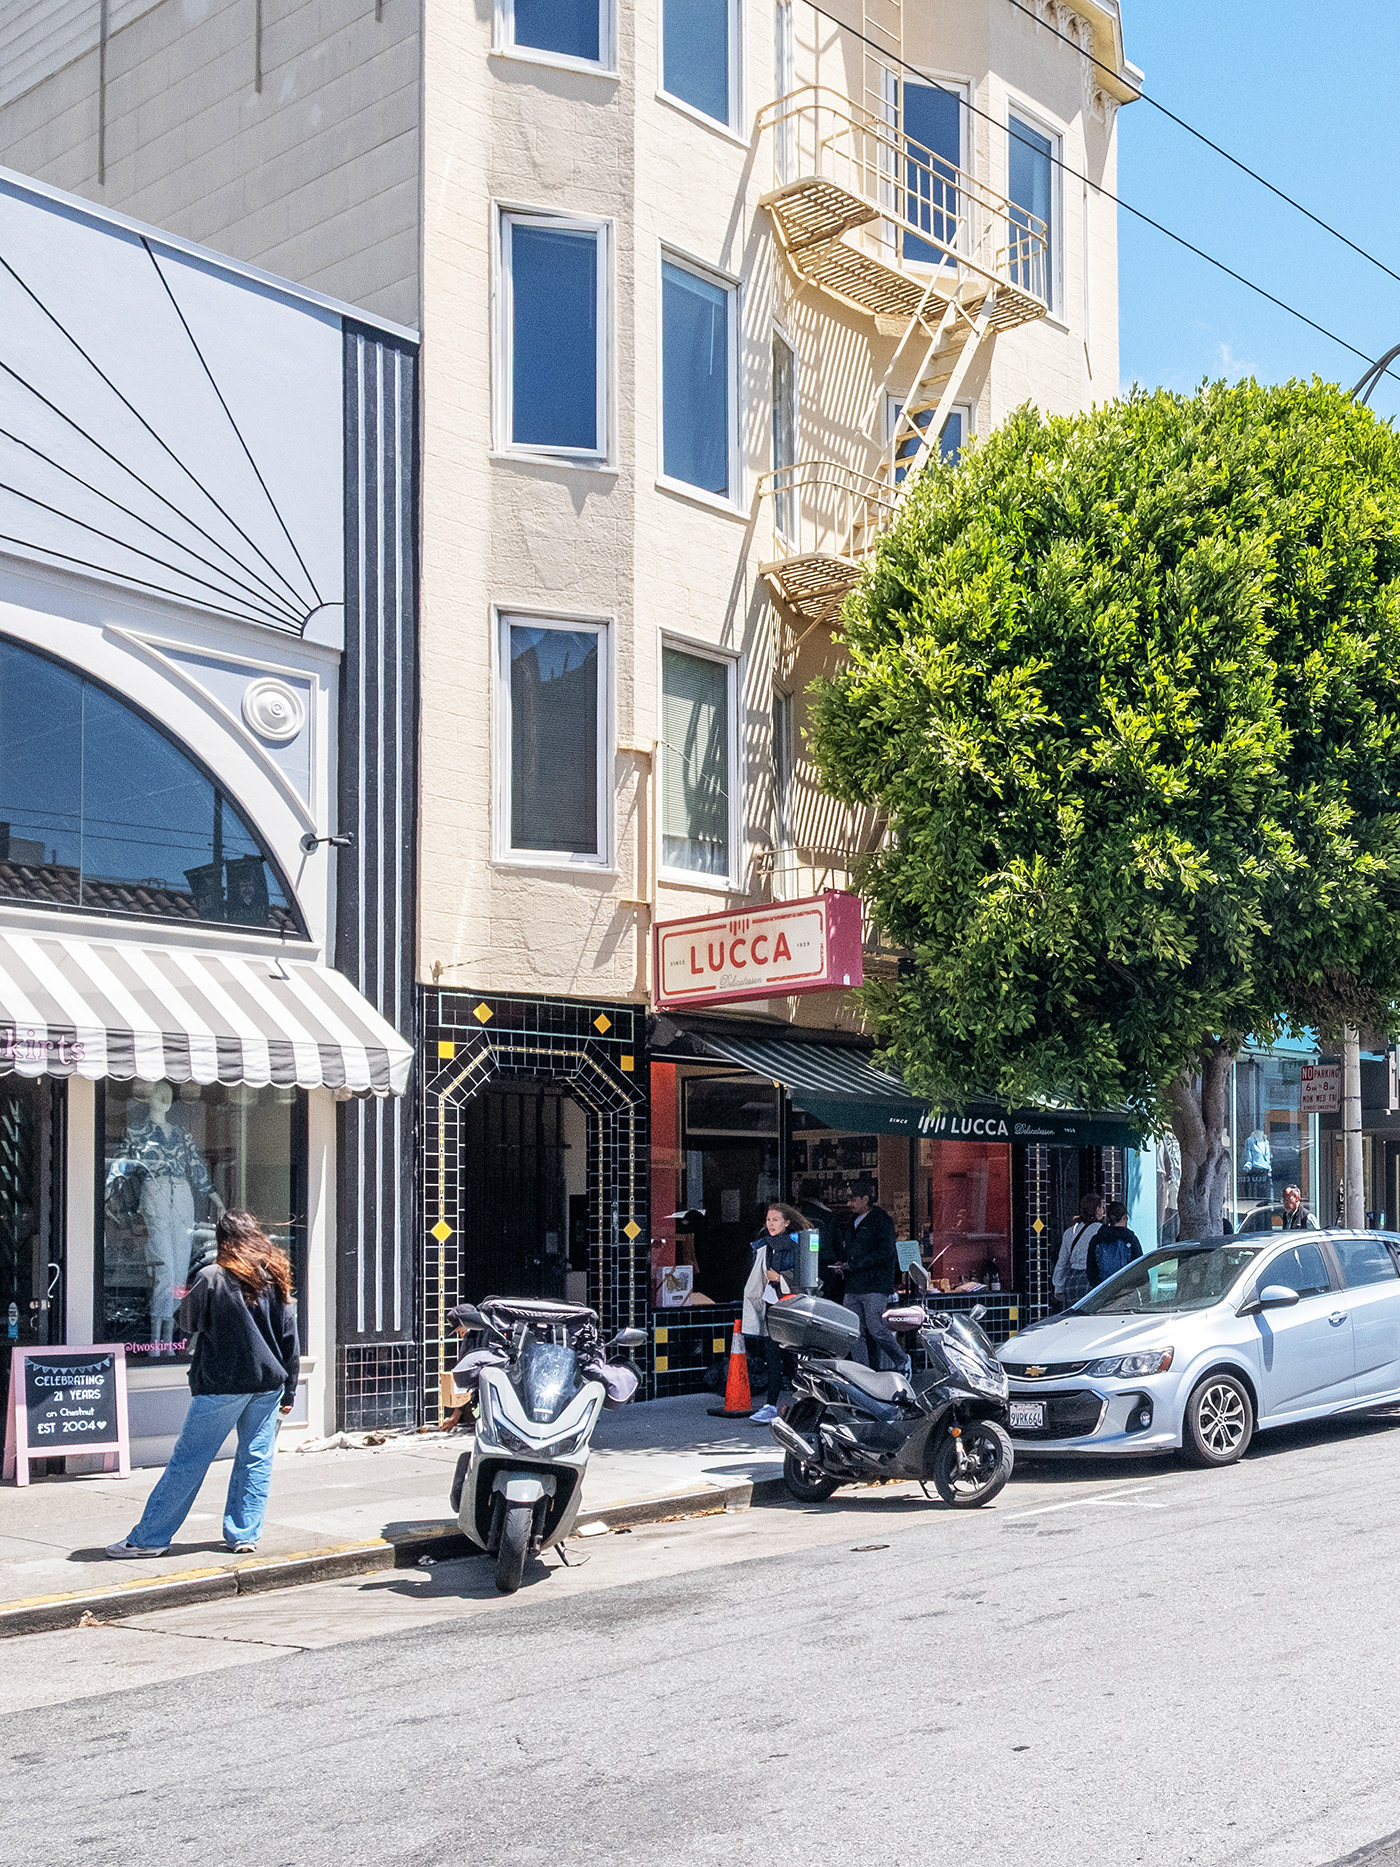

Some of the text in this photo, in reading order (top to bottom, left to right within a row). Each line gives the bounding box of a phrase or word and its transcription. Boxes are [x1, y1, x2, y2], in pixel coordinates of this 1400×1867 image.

[690, 932, 792, 974] LUCCA
[1302, 1067, 1339, 1080] NO PARKING
[1315, 1094, 1326, 1102] WED
[950, 1117, 1009, 1136] LUCCA
[125, 1338, 188, 1354] @twoskirtssf
[34, 1374, 105, 1387] CELEBRATING
[53, 1389, 101, 1402] 21 YEARS
[59, 1406, 95, 1417] Chestnut
[1011, 1412, 1042, 1425] 9VRK664
[37, 1420, 96, 1434] EST 2004
